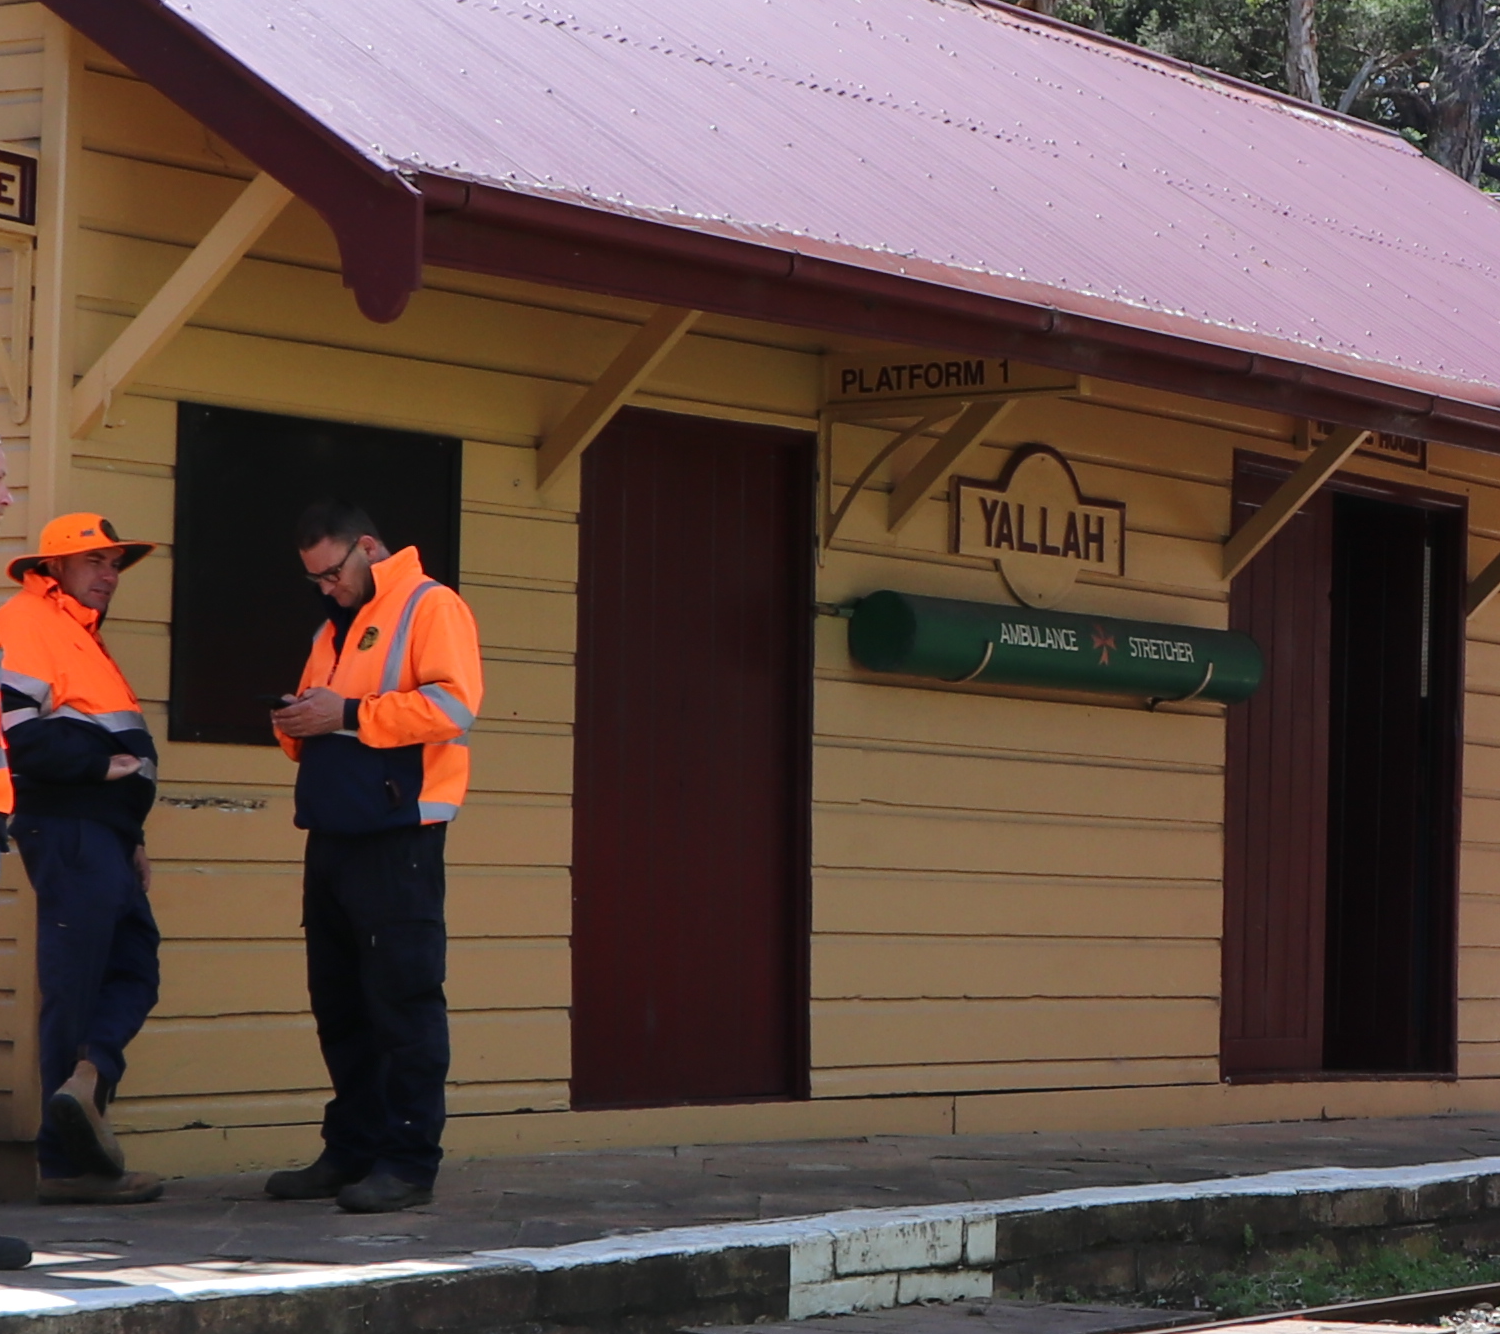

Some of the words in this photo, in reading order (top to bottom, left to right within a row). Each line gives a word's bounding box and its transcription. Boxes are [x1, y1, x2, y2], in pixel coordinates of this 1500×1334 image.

[841, 359, 984, 394] PLATFORM
[998, 358, 1009, 383] 1
[979, 496, 1104, 563] YALLAH
[1000, 622, 1079, 651] AMBULANCE
[1128, 636, 1195, 663] STRETCHER
